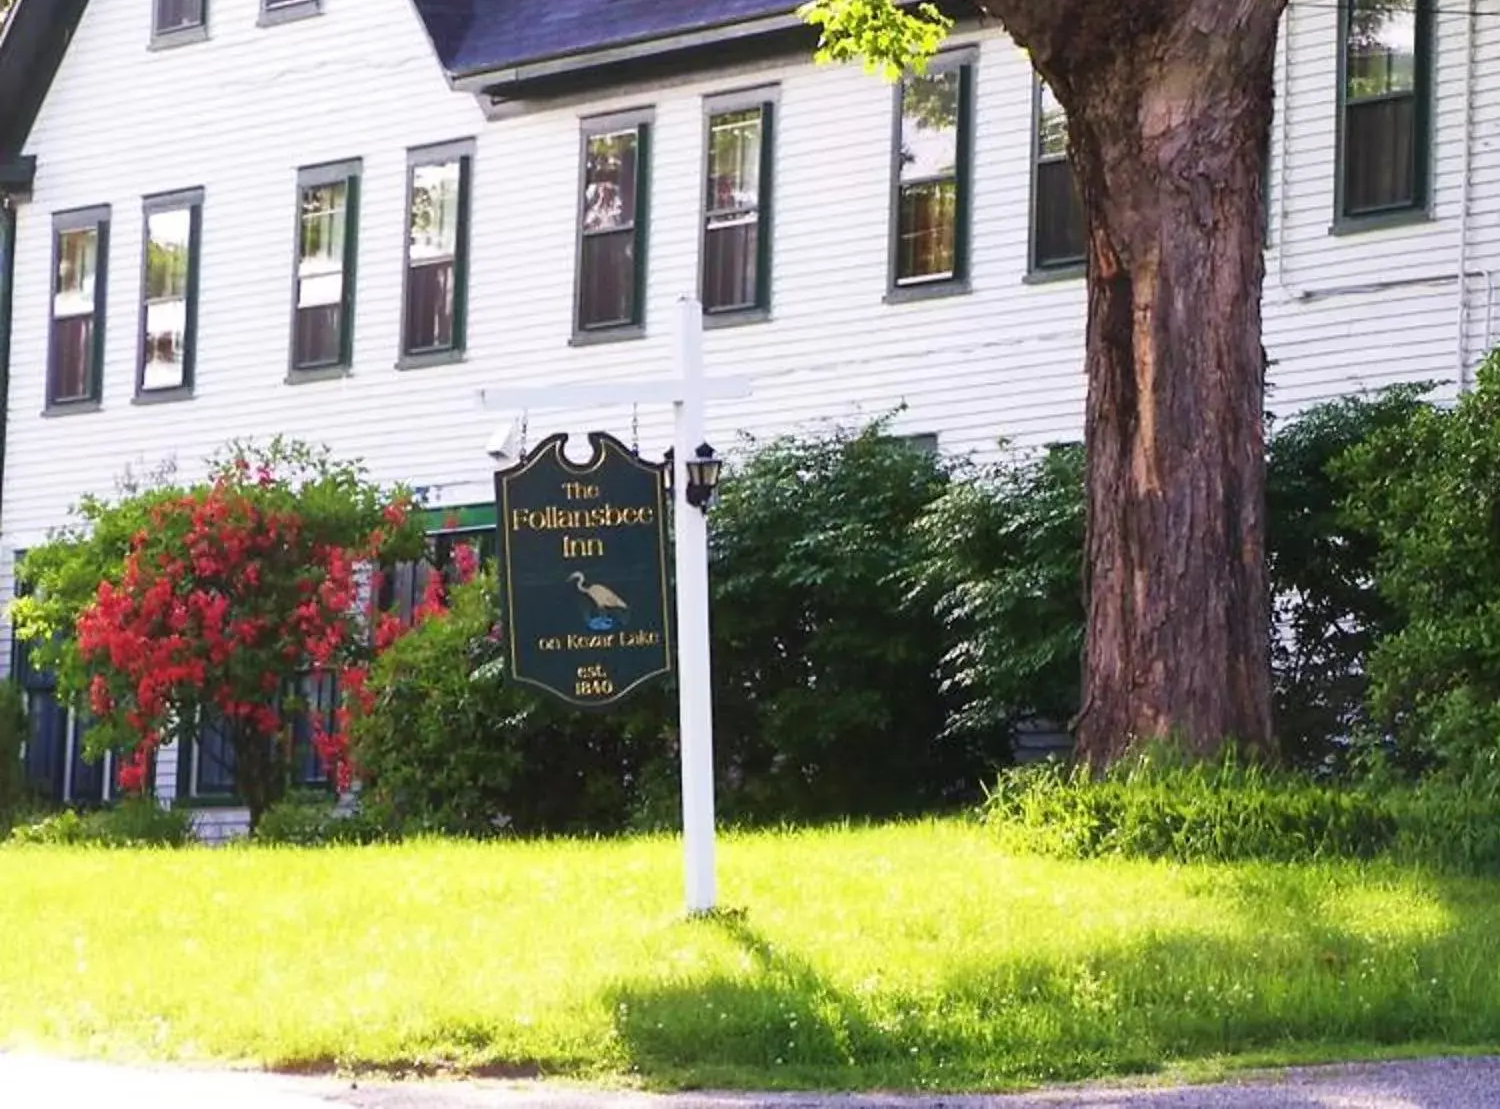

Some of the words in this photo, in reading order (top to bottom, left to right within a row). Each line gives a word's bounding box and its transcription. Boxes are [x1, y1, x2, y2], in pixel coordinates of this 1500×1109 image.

[562, 481, 599, 500] The
[512, 503, 653, 531] Follansbee
[563, 535, 603, 558] Inn
[539, 638, 561, 650] on
[567, 634, 612, 650] Kezar
[619, 629, 660, 646] Lake
[577, 664, 607, 678] est.
[575, 680, 614, 696] 1840
